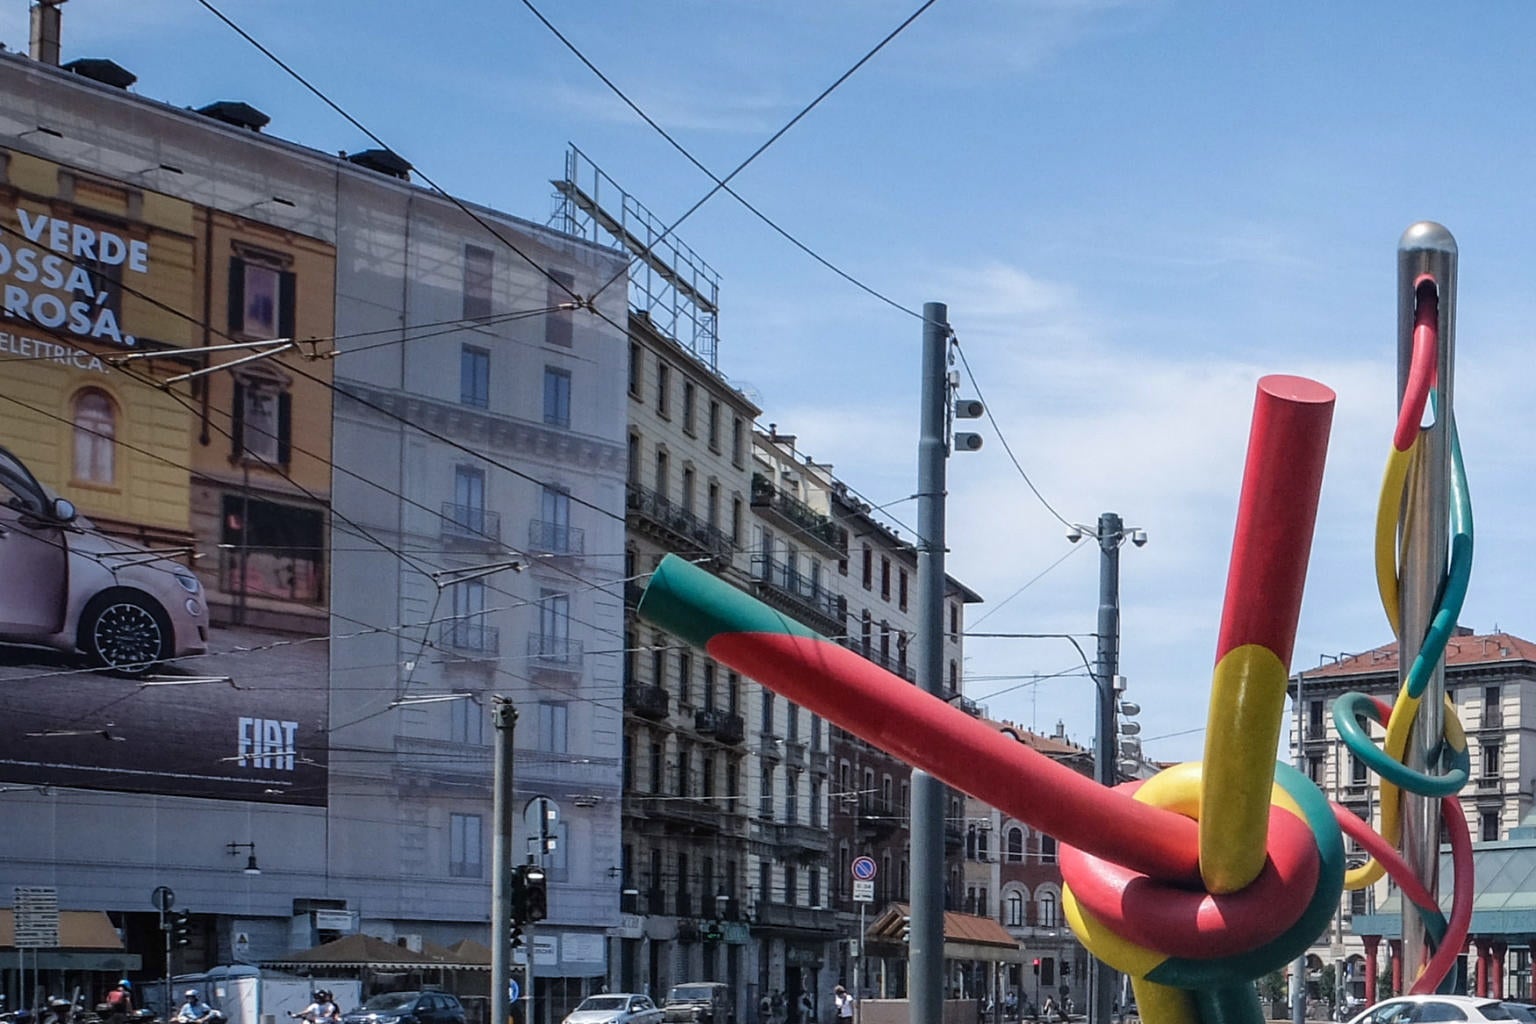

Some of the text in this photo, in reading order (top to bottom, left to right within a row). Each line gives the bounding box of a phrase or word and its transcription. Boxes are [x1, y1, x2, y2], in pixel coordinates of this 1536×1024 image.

[16, 208, 149, 274] VERDE
[4, 284, 136, 346] ROSA.
[238, 716, 299, 771] FIAT
